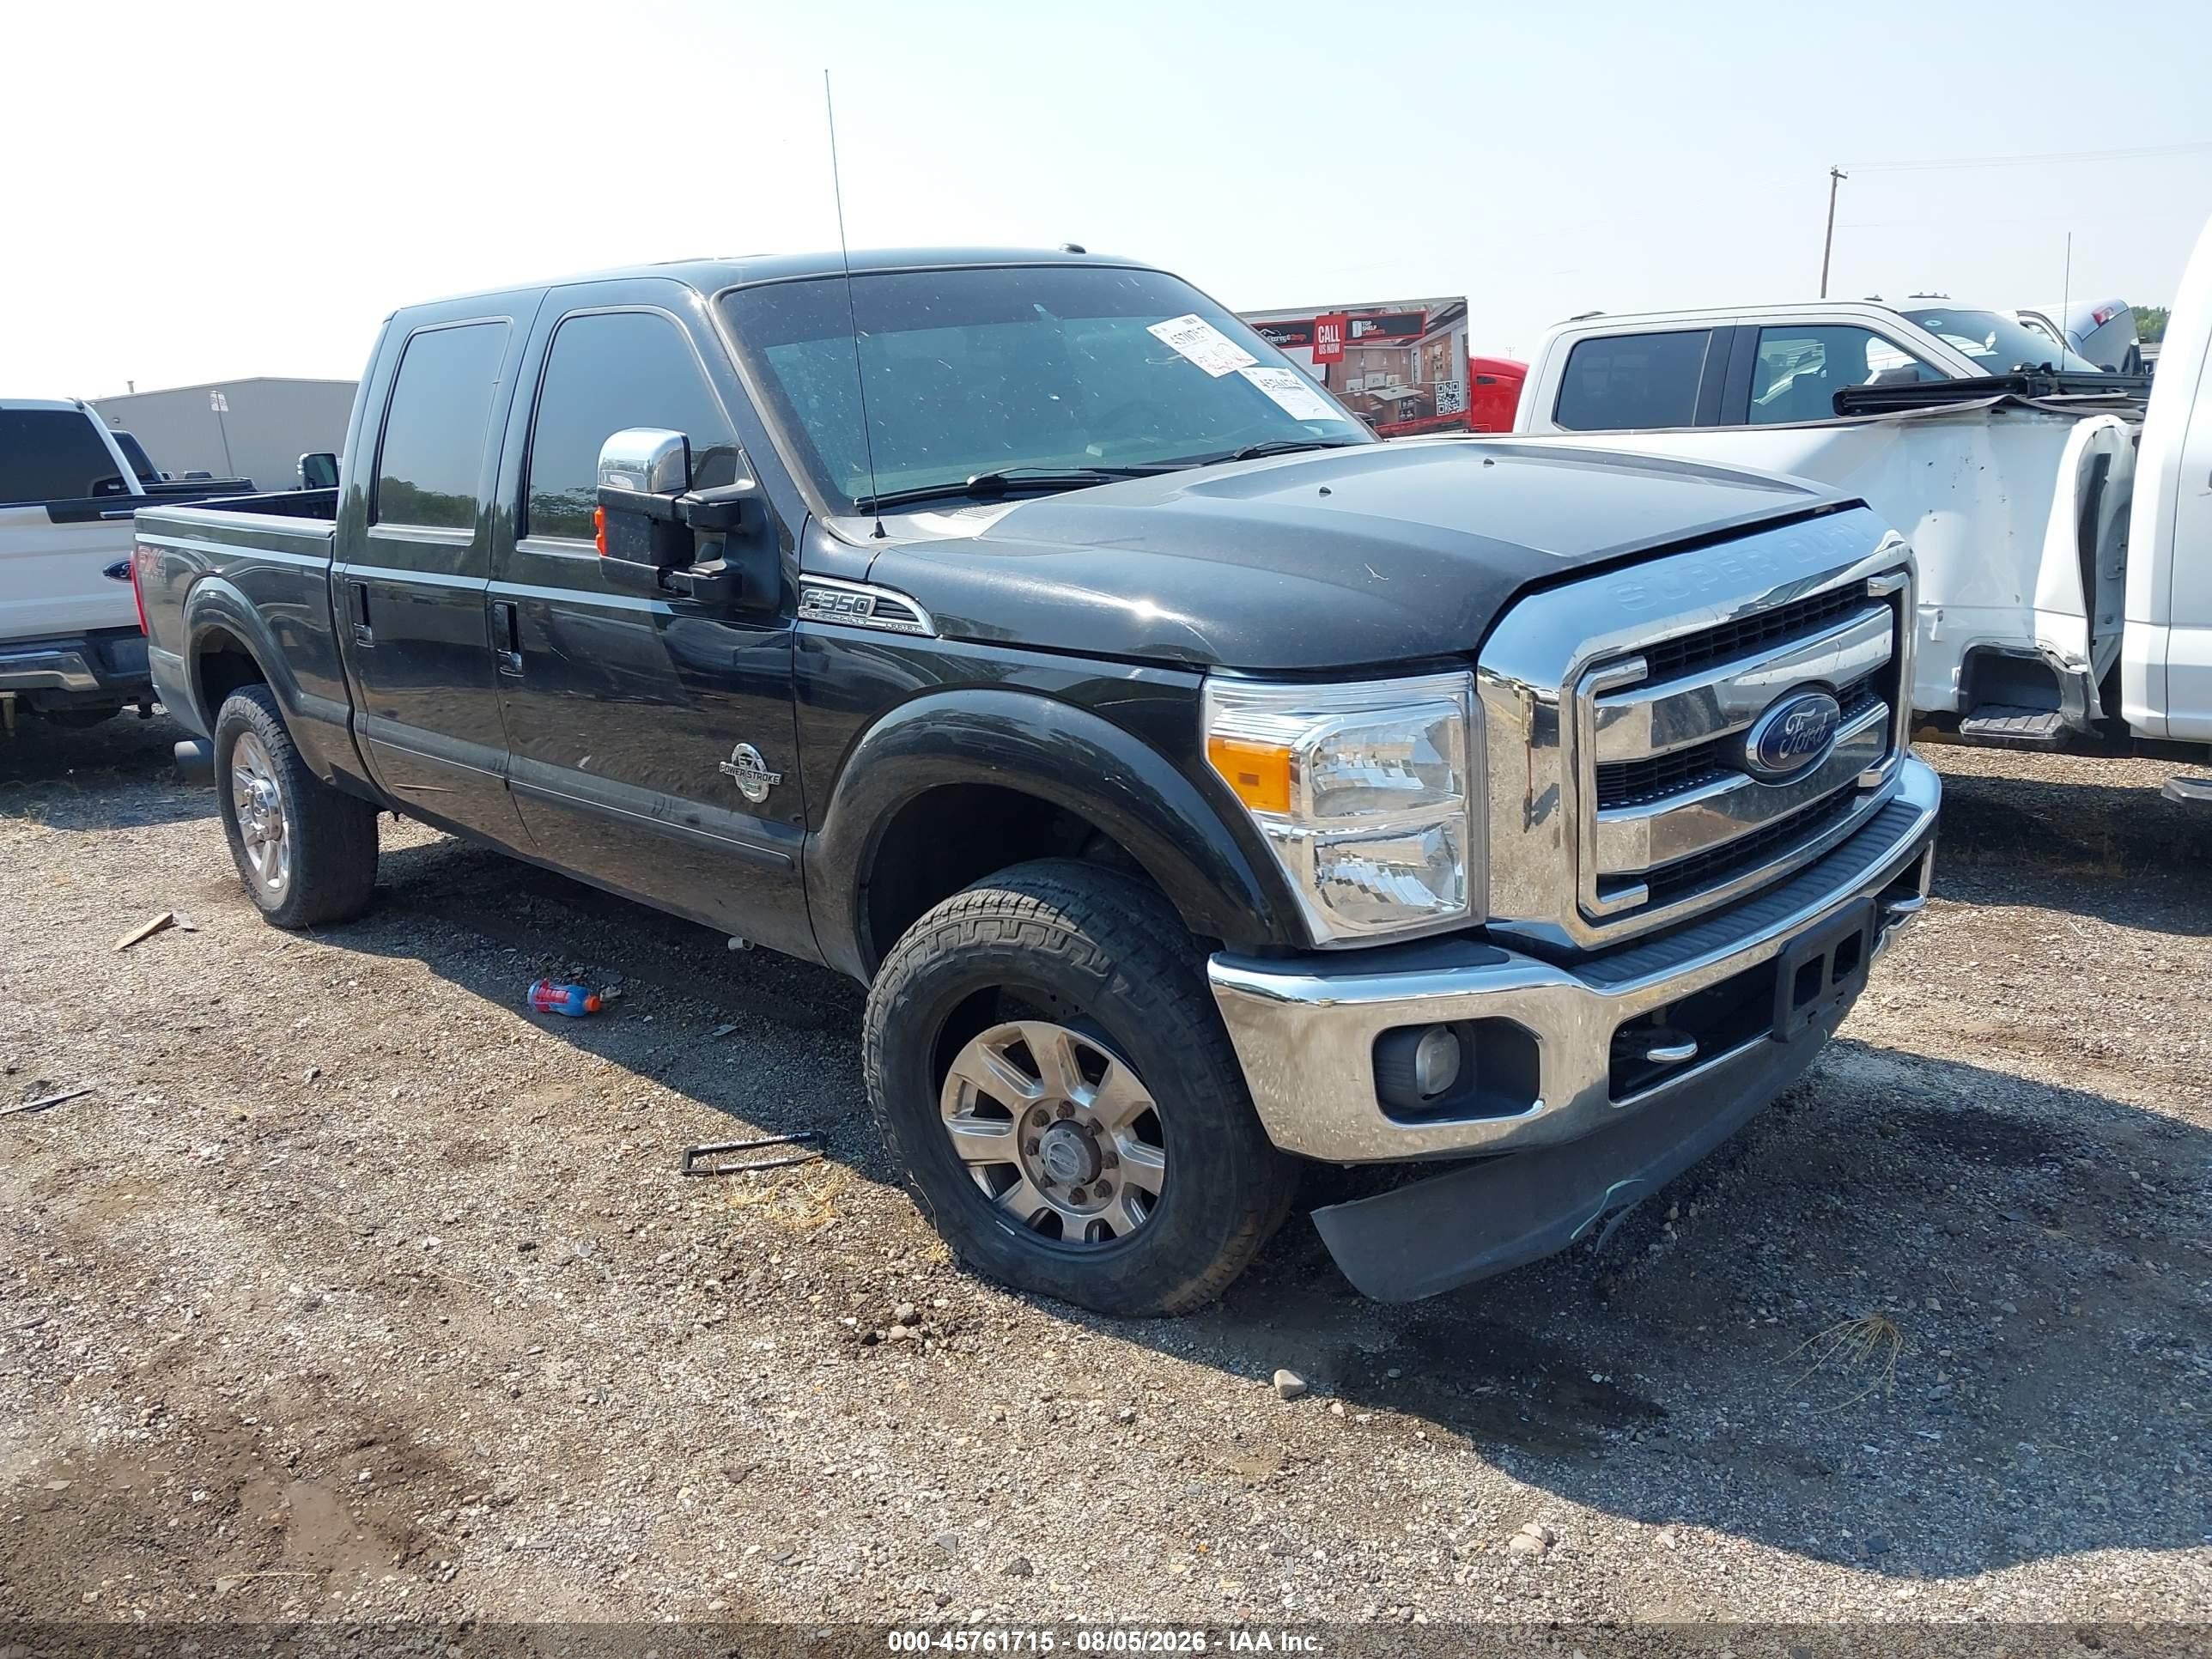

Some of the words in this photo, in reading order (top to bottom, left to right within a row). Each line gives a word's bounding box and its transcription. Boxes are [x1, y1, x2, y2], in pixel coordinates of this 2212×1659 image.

[1318, 325, 1340, 343] CALL
[1318, 344, 1327, 355] US
[1327, 343, 1340, 354] NOW
[1607, 548, 1779, 611] SUPER
[1781, 522, 1872, 563] DUTY
[1779, 707, 1828, 759] Ford
[720, 764, 745, 778] POWER
[746, 769, 781, 785] STROKE
